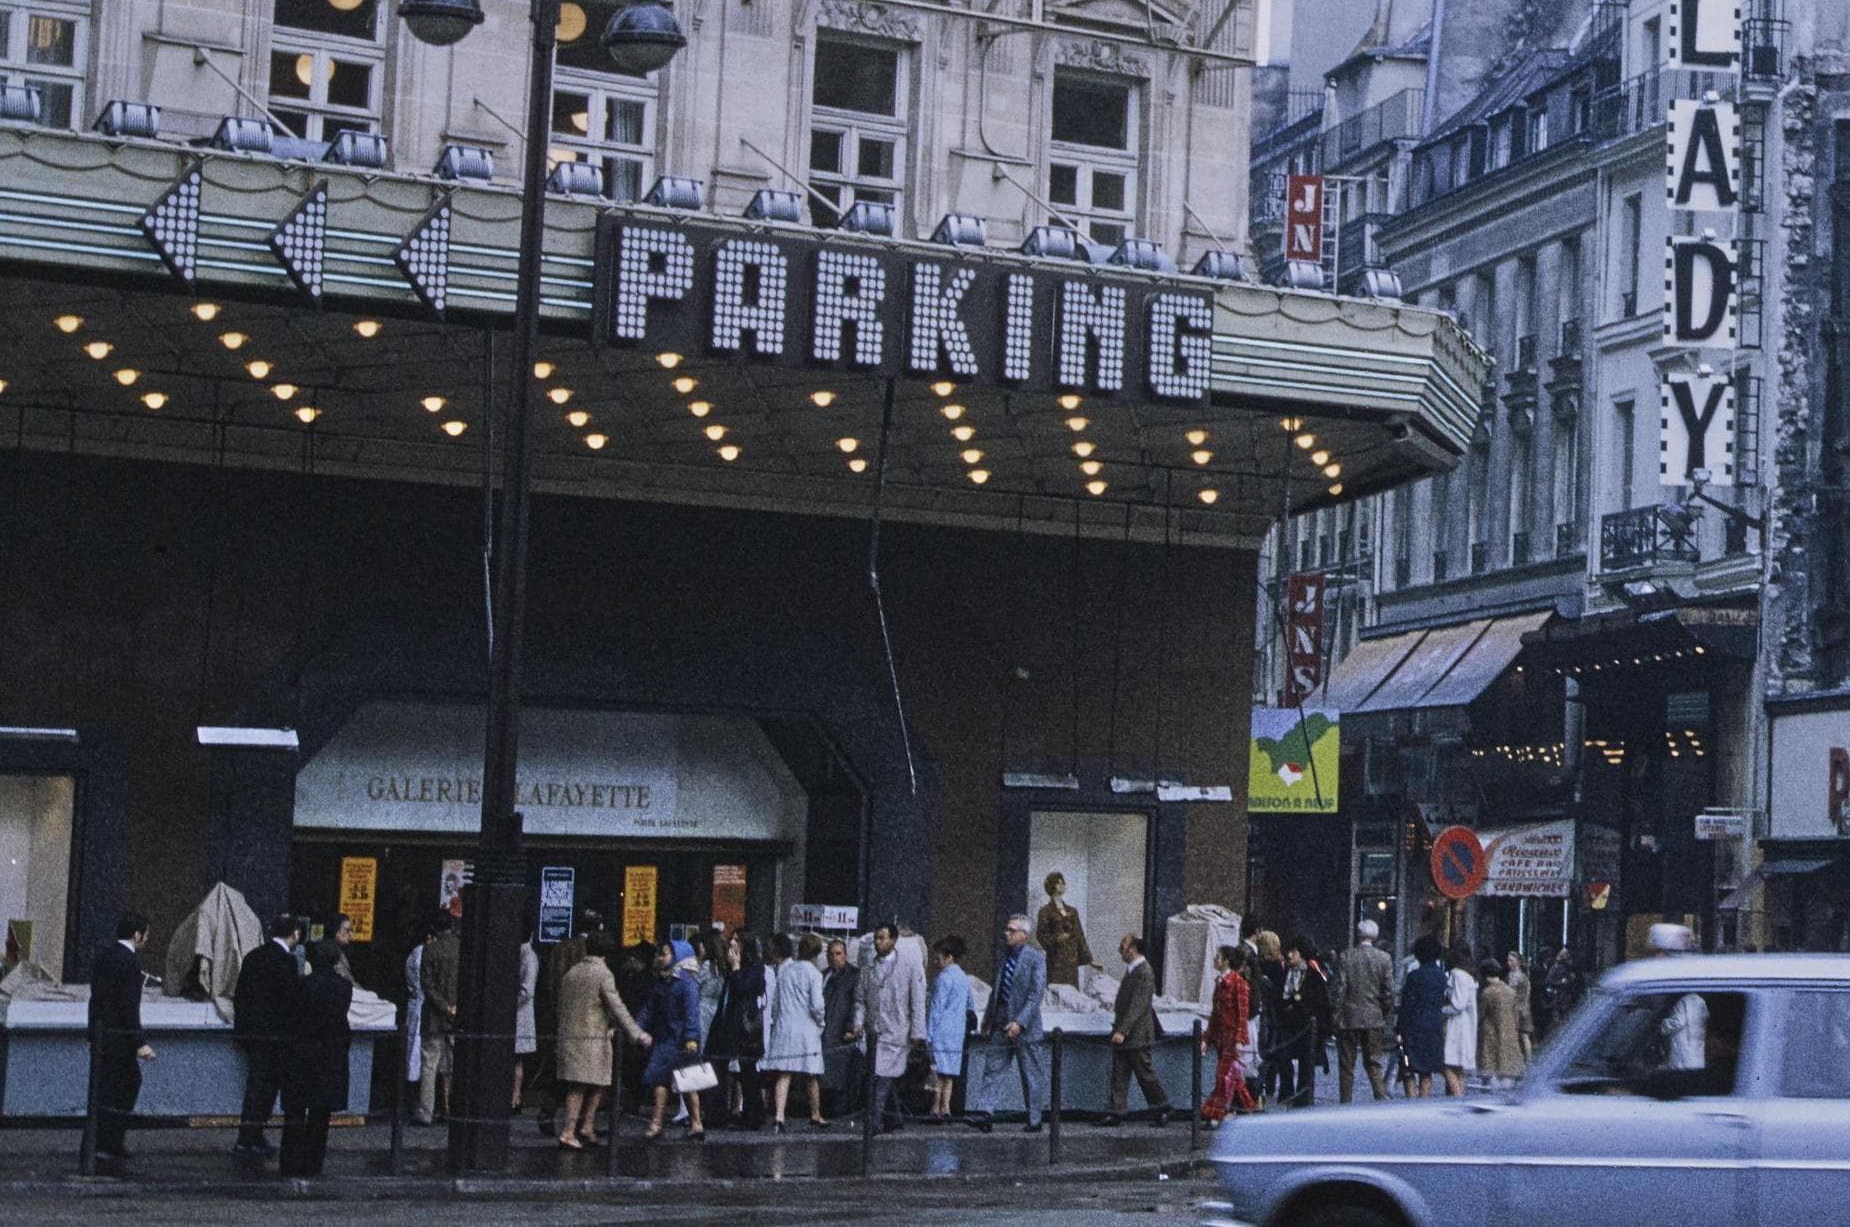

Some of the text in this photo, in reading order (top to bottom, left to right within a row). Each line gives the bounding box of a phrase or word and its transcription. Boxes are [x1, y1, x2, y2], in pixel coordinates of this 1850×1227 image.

[616, 225, 1213, 399] PARKING
[367, 776, 650, 810] GALERIE LAFAYETTE
